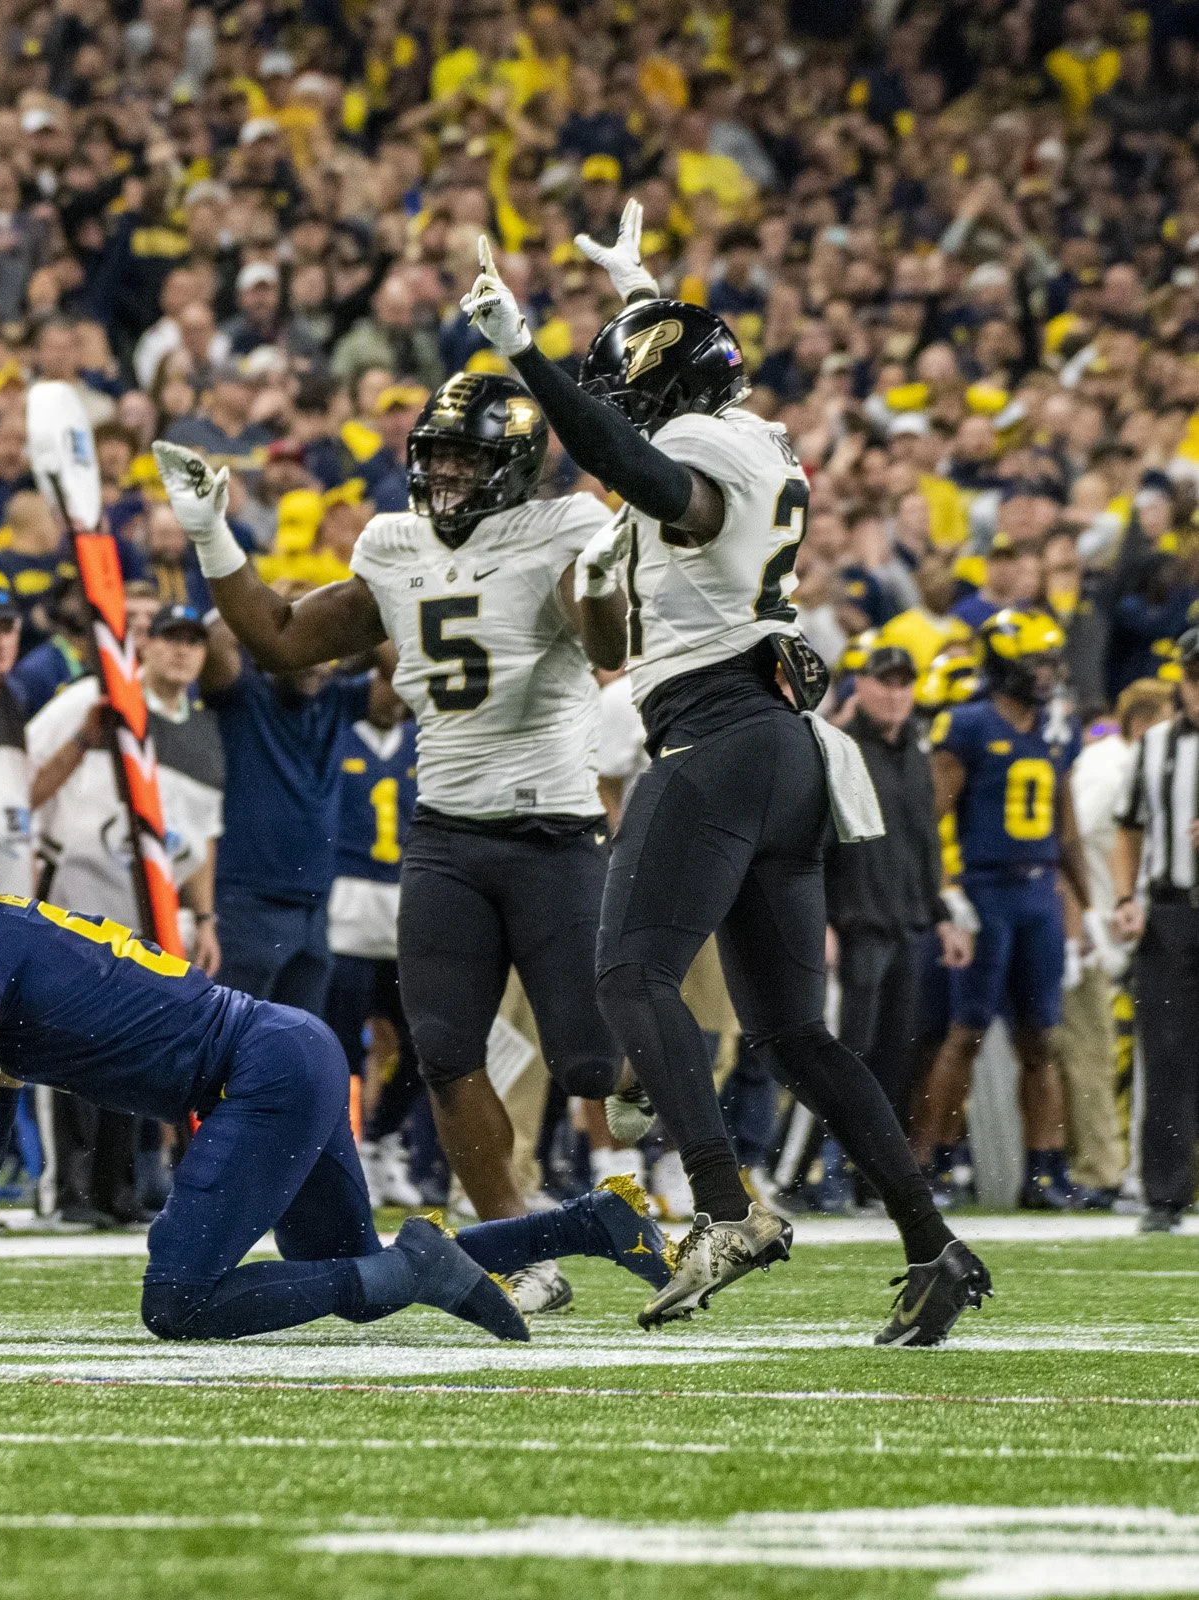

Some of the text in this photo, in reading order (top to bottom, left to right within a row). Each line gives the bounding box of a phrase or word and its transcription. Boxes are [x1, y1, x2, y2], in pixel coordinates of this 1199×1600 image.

[419, 594, 492, 714] 5
[369, 777, 401, 864] 1
[1004, 758, 1054, 841] 0
